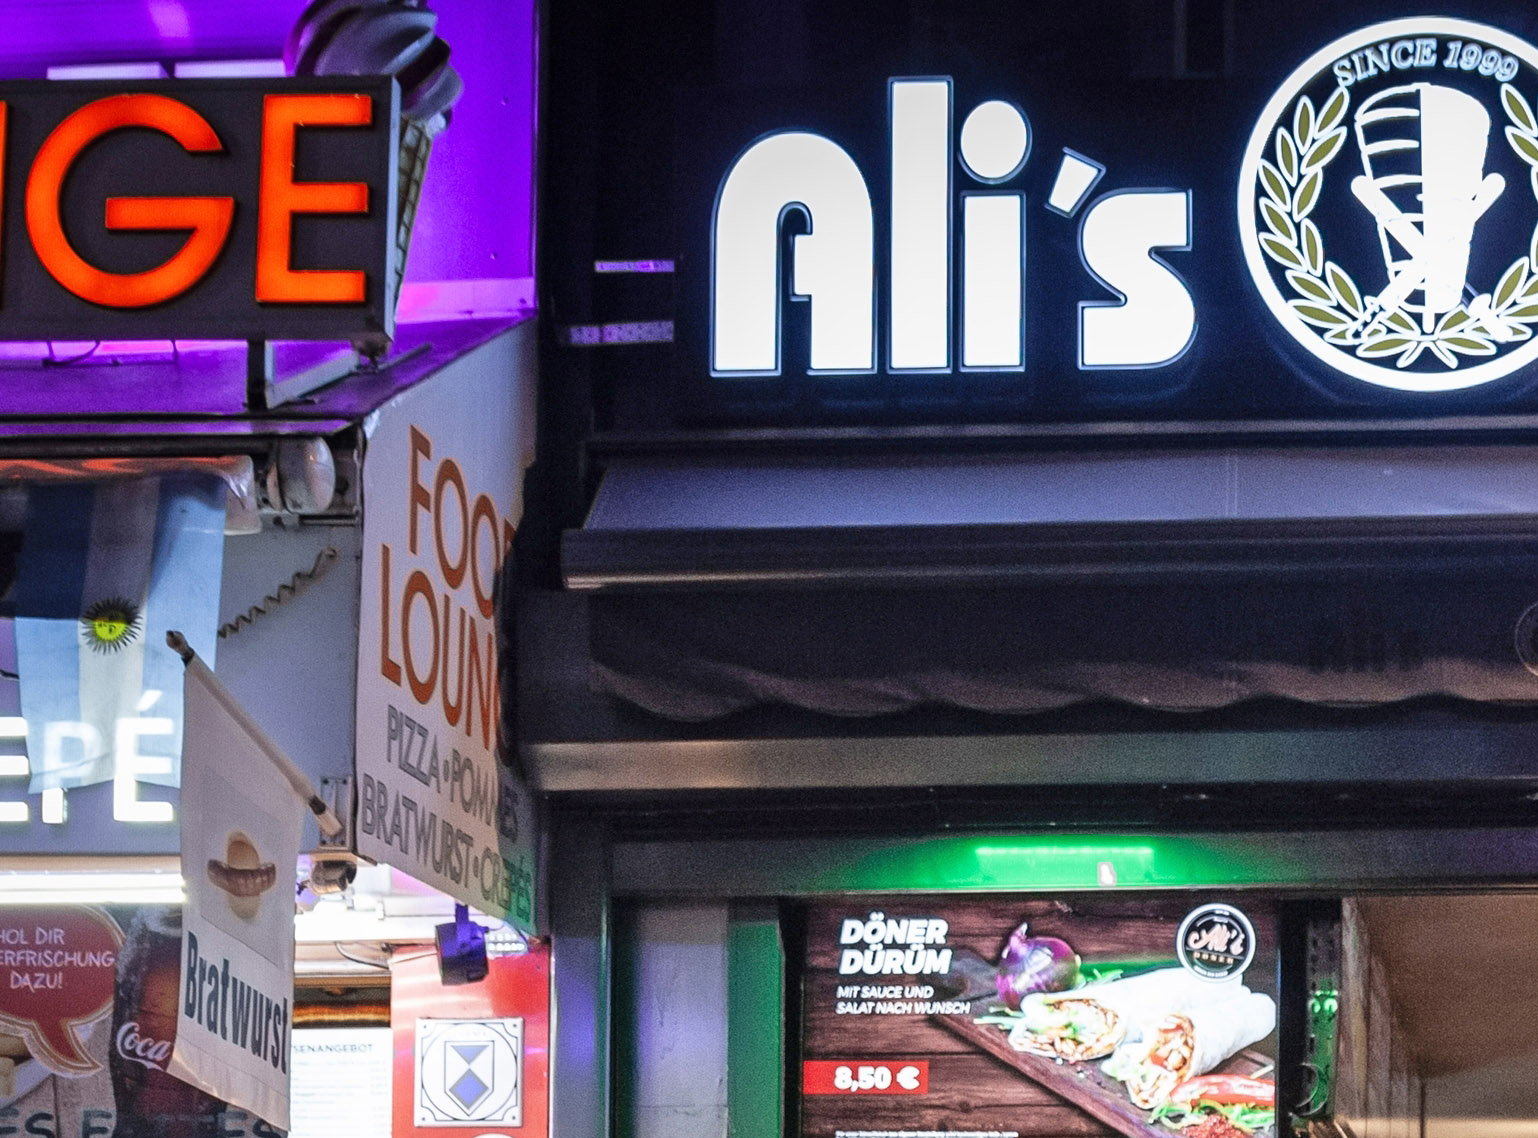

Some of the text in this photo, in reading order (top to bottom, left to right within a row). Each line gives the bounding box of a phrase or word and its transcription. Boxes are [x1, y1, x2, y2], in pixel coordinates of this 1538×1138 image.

[1332, 38, 1520, 87] SINCE 1999
[0, 94, 372, 308] GE
[710, 76, 1199, 377] Ali's
[381, 543, 502, 752] LOUN
[387, 703, 441, 794] PIZZA
[361, 772, 475, 889] BRATWURST
[35, 926, 65, 946] DIR
[840, 911, 949, 944] DÖNER
[838, 943, 953, 975] DÜRÜM
[10, 969, 63, 993] DAZU!
[836, 985, 935, 999] MIT SAUCE UND
[184, 930, 288, 1075] Bratwurst
[836, 1001, 972, 1015] SALAT NACH WUNSCH
[833, 1065, 921, 1093] 8,50 €
